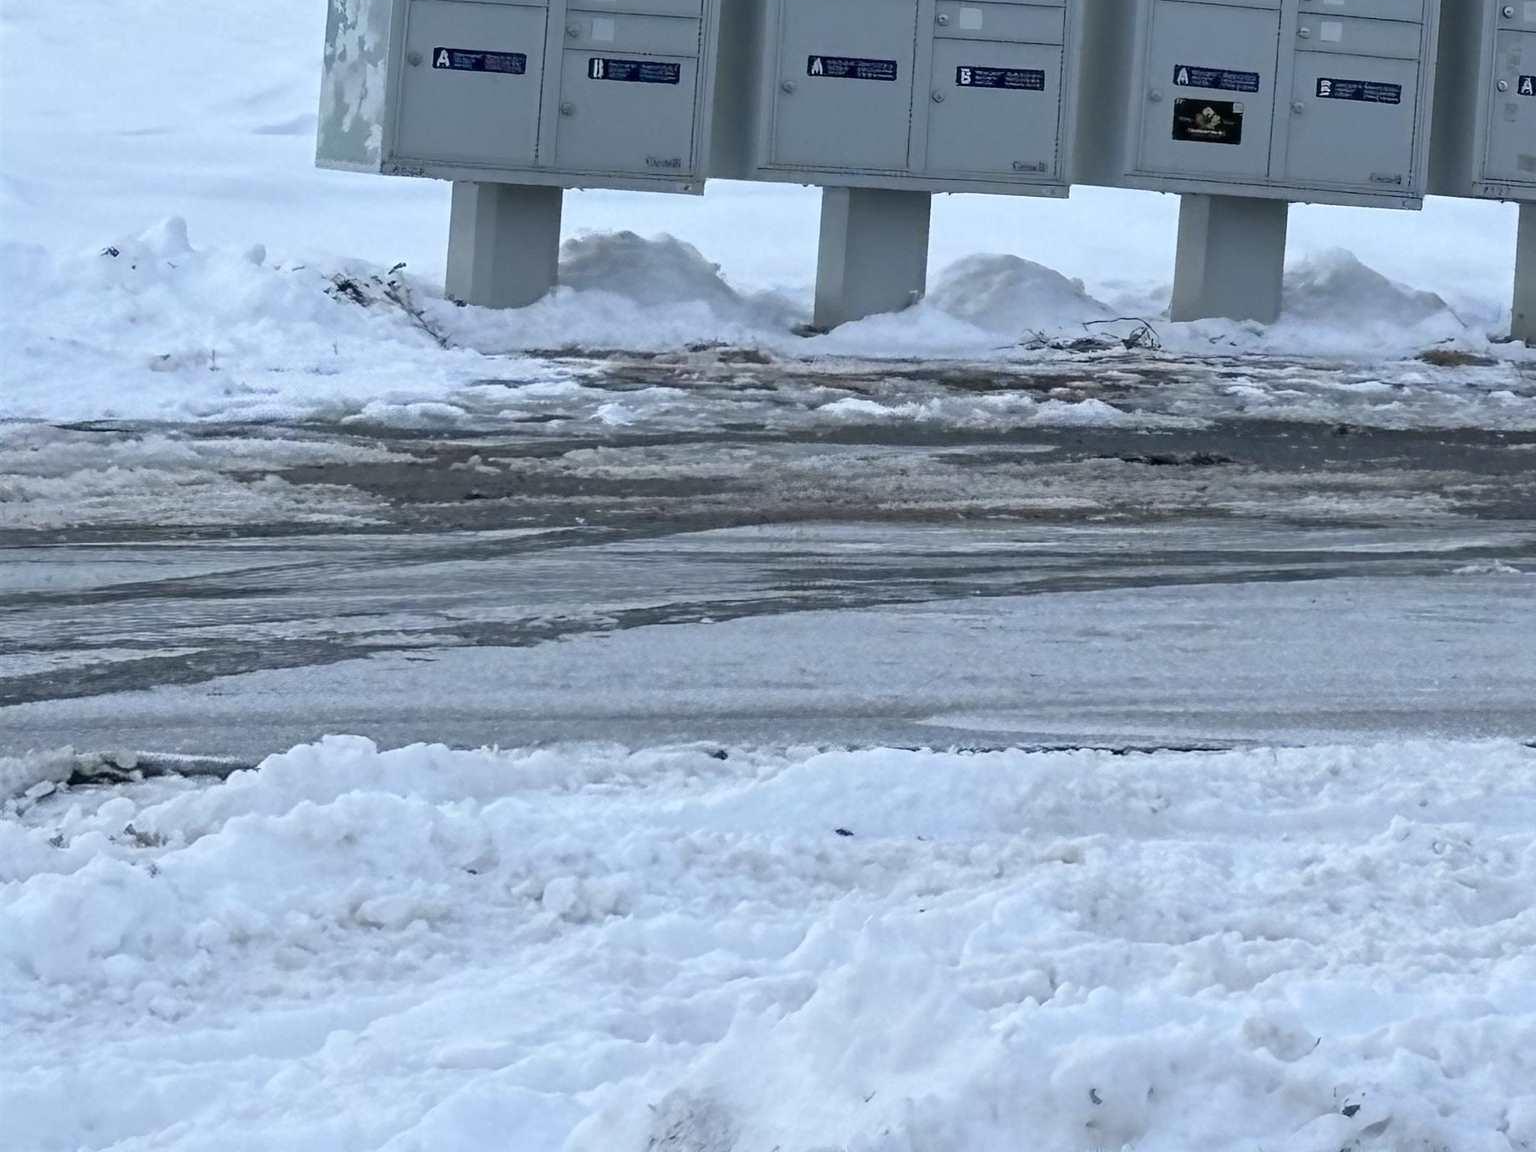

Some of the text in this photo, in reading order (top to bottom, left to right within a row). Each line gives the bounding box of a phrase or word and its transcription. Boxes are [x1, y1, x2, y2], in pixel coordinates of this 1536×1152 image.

[436, 48, 450, 68] A
[811, 57, 823, 75] A
[960, 67, 971, 84] B
[1177, 66, 1189, 86] A
[1320, 79, 1332, 97] B
[1521, 77, 1534, 95] A
